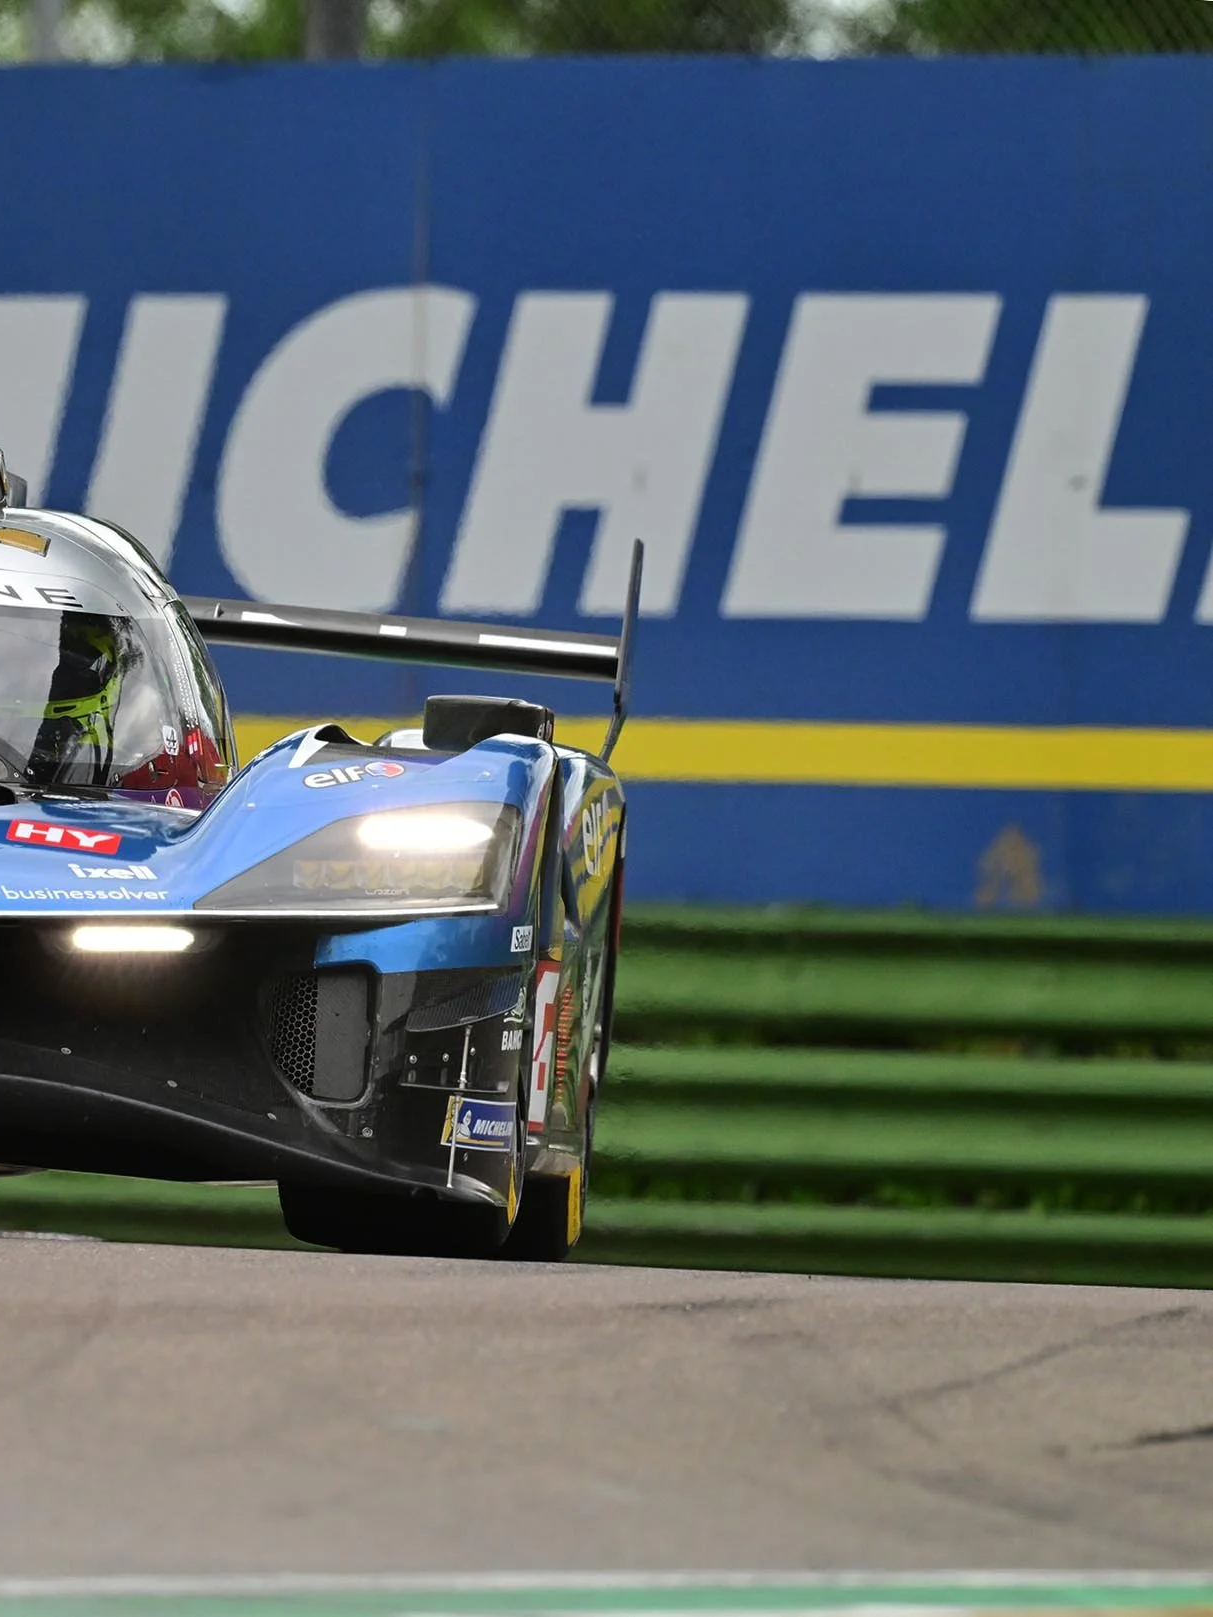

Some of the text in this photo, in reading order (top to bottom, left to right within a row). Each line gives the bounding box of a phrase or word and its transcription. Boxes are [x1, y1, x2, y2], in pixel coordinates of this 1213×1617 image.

[304, 765, 367, 788] elf
[14, 822, 116, 849] HY
[67, 863, 159, 880] ixell
[0, 885, 170, 901] businessolver
